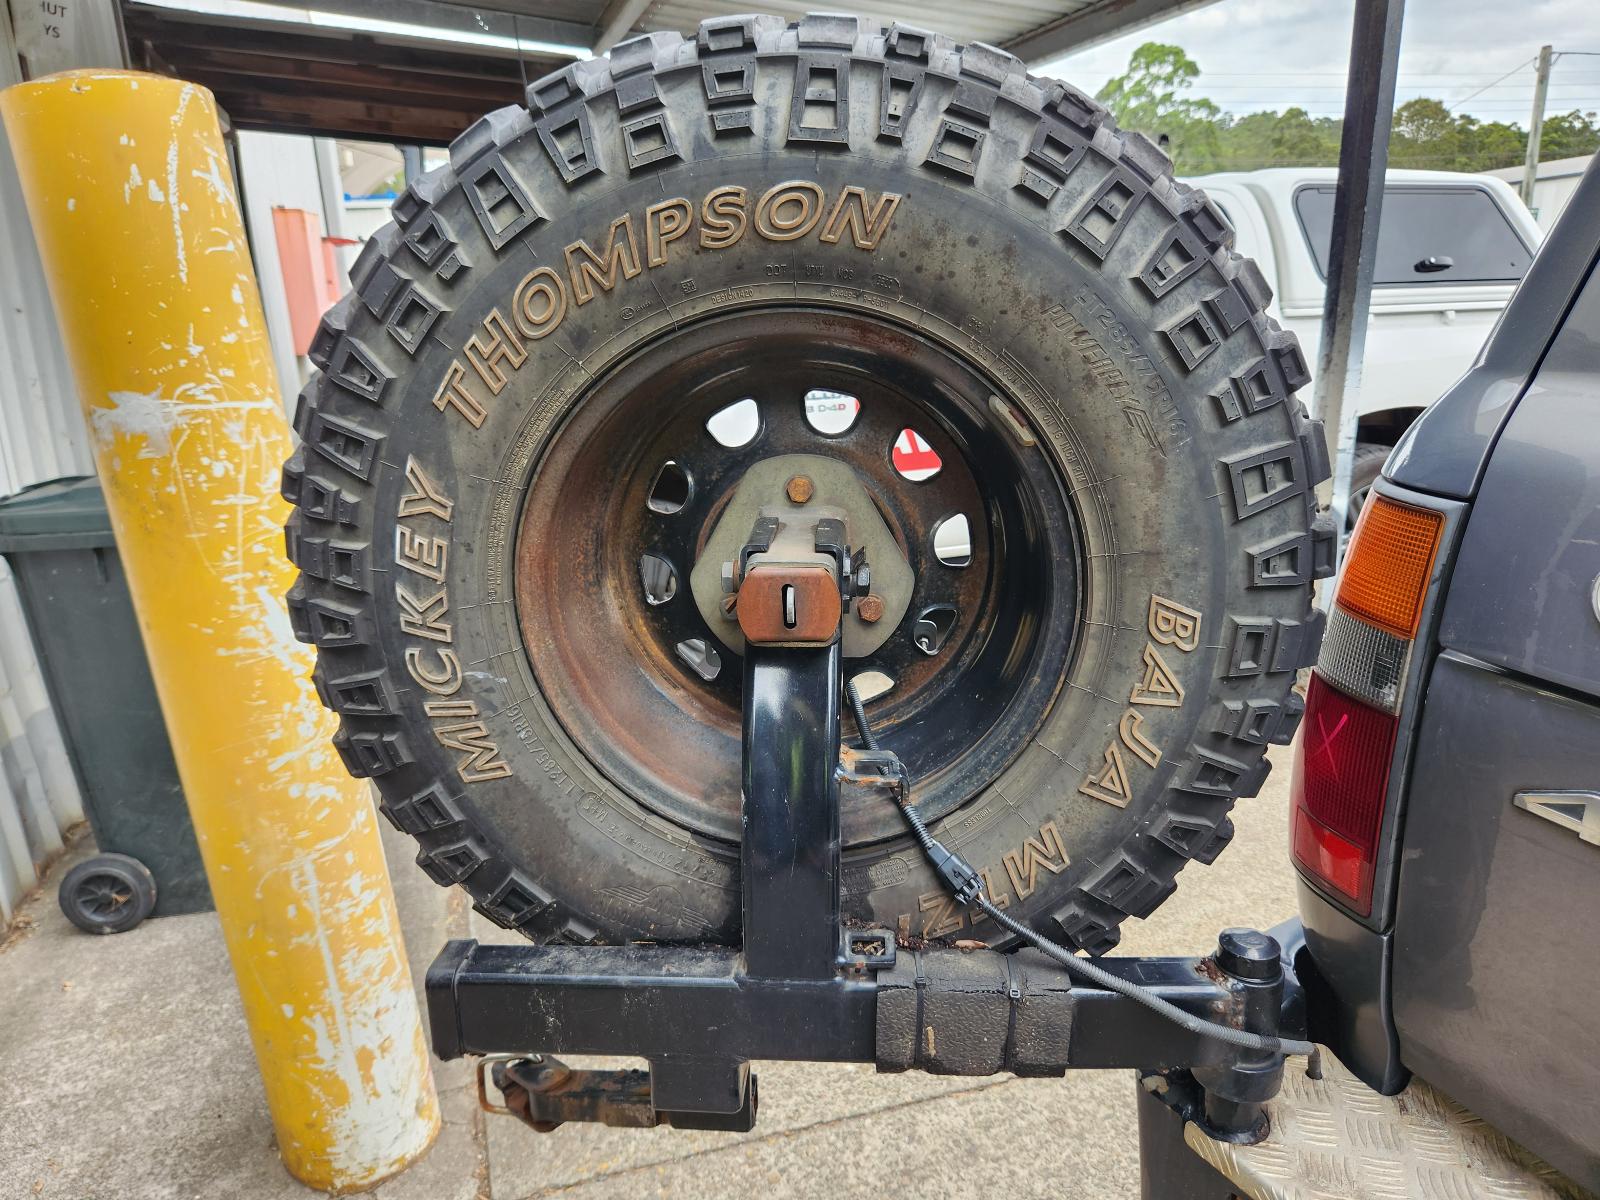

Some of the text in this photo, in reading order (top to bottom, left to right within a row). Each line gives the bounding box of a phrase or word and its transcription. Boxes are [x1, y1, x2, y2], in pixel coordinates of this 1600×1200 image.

[1040, 303, 1142, 406] POWERPLY
[394, 180, 902, 785] MICKEY THOMPSON
[1078, 594, 1202, 809] BAJA
